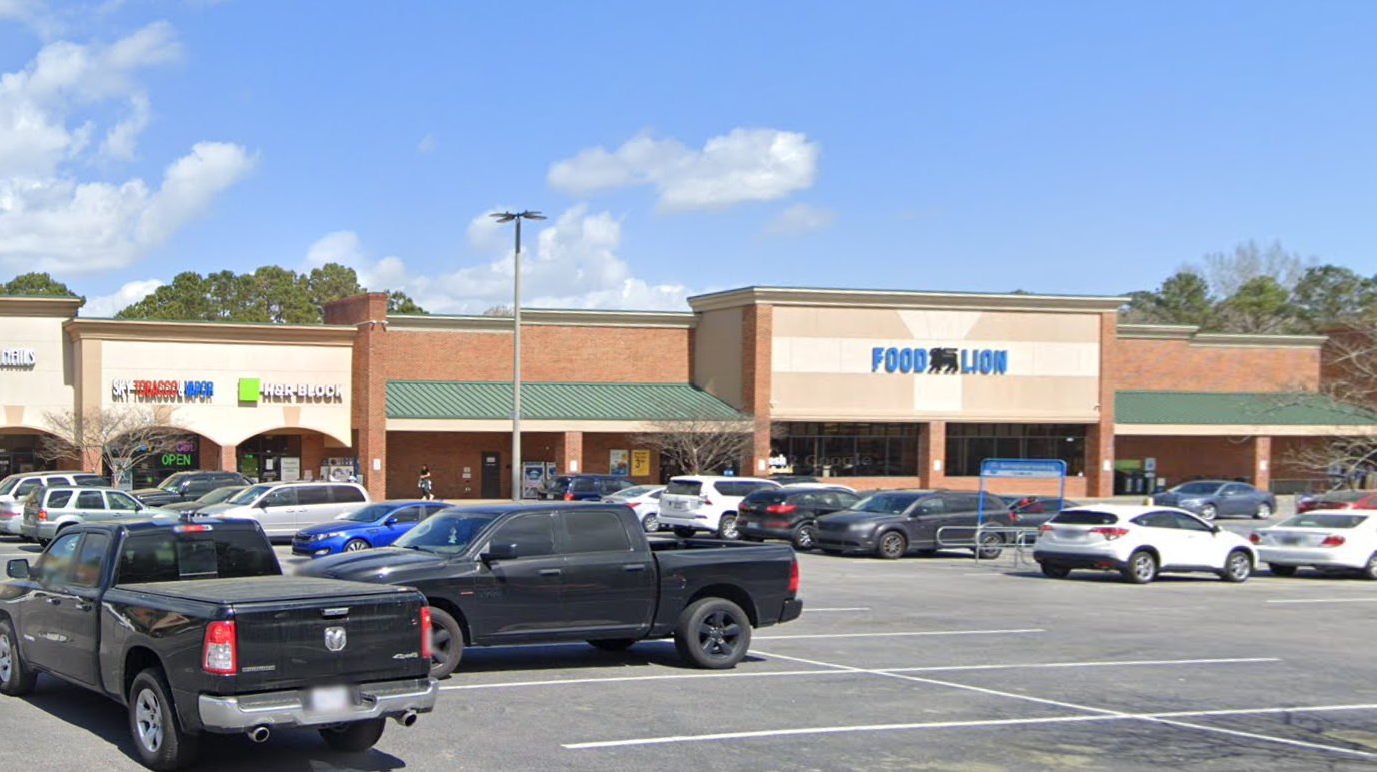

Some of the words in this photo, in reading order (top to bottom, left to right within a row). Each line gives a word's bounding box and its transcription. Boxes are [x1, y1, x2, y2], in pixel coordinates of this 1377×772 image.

[872, 347, 927, 373] FOOD
[961, 349, 1008, 374] LION
[112, 380, 131, 395] SKY
[134, 380, 178, 396] TOBACCO
[184, 381, 213, 396] VAPOR
[264, 383, 292, 396] H&R
[297, 384, 343, 397] BLOCK
[161, 454, 191, 466] OPEN
